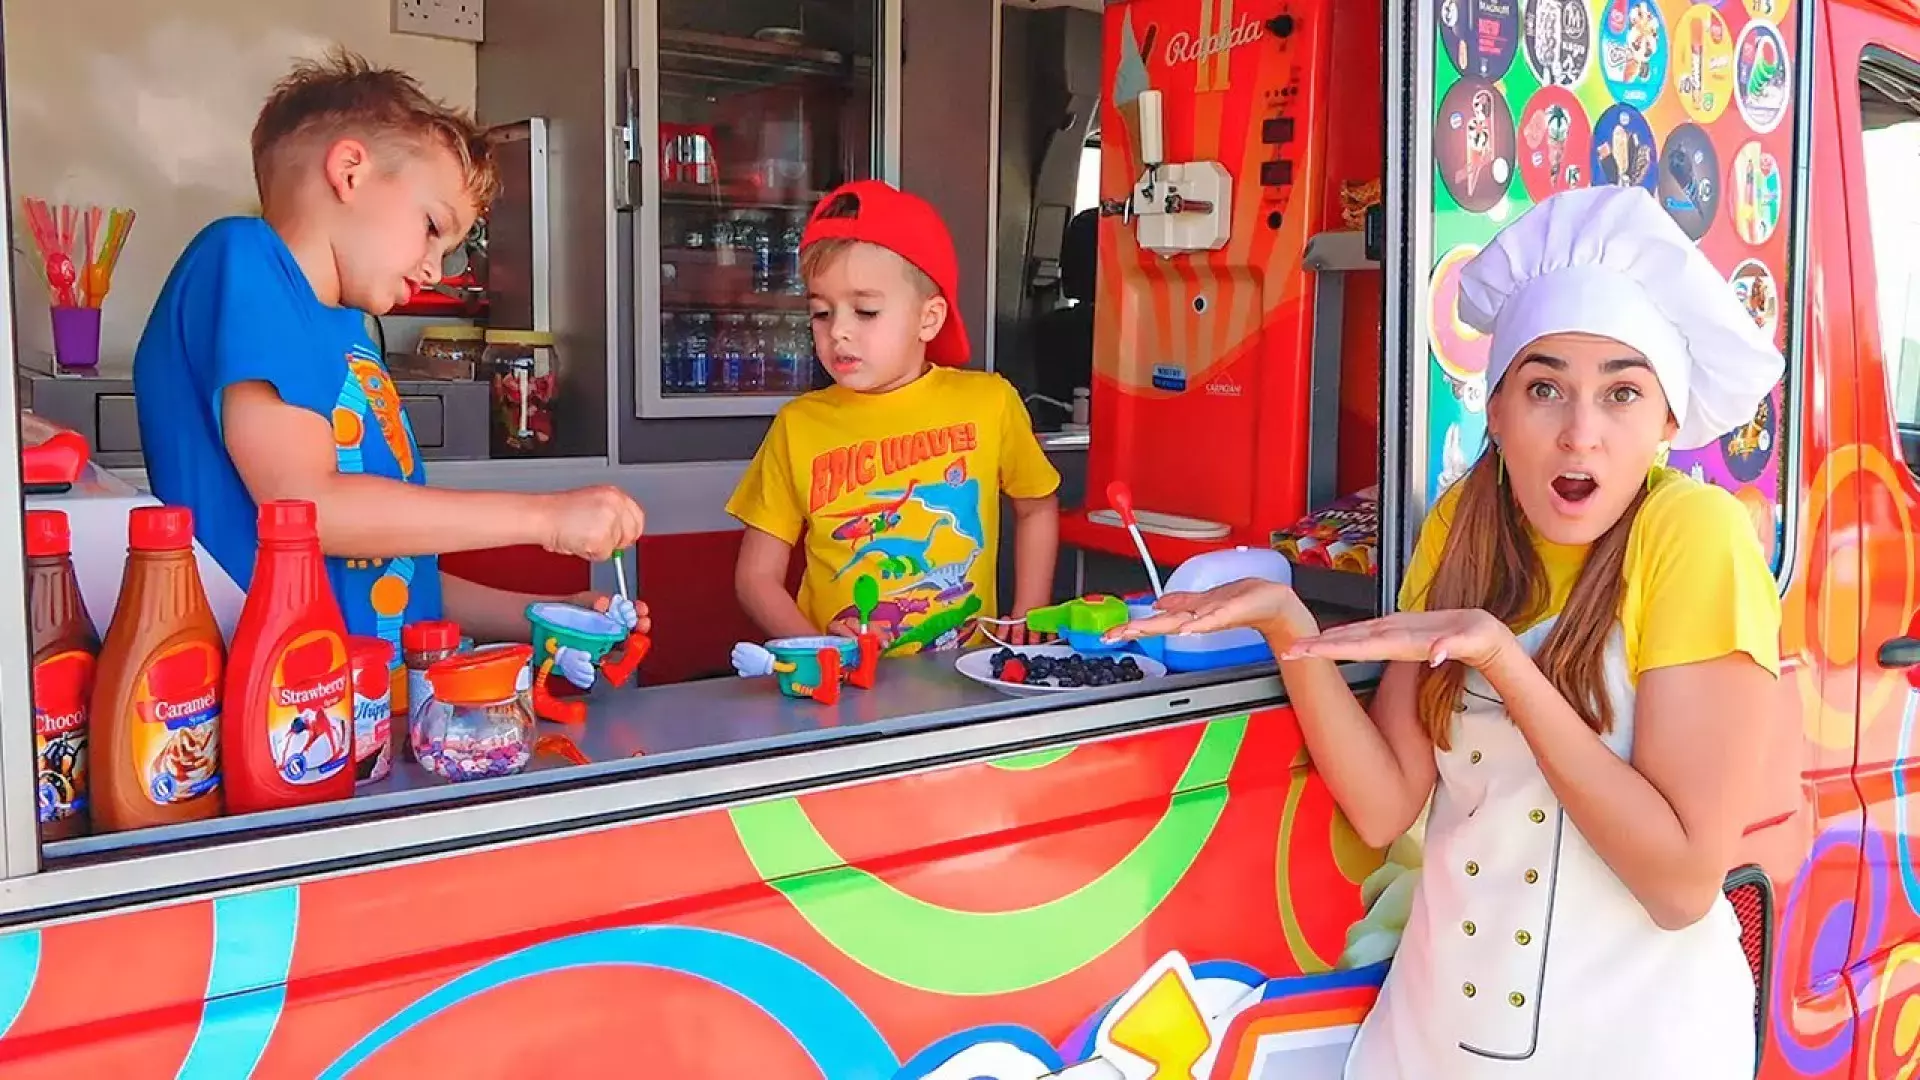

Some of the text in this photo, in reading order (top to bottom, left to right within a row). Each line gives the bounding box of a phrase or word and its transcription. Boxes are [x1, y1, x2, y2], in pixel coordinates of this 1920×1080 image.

[1165, 12, 1264, 66] Rapida
[810, 422, 978, 514] EPIC WAVE!
[155, 688, 216, 721] Caramel
[281, 675, 346, 704] Strawberry
